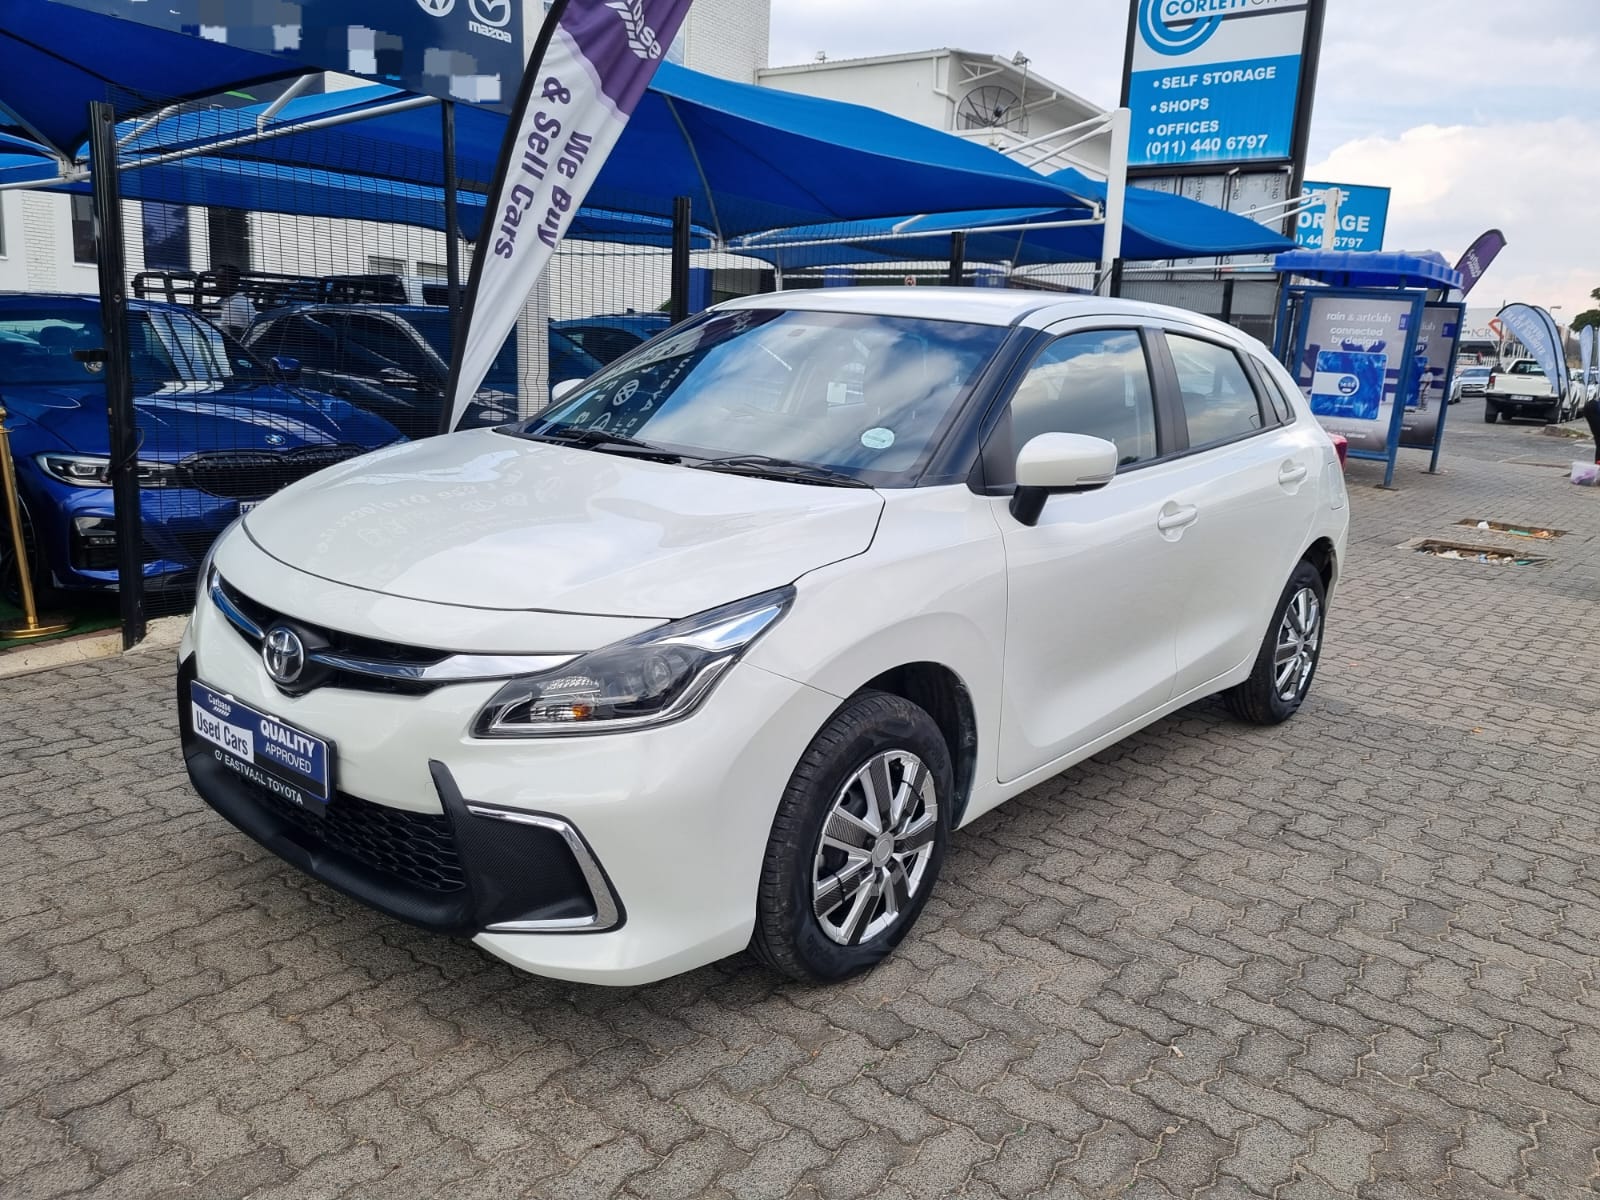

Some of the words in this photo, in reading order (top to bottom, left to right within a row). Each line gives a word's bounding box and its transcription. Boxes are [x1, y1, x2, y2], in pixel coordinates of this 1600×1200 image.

[468, 20, 512, 44] mazda
[541, 76, 571, 105] &
[1161, 74, 1198, 90] SELF
[1202, 66, 1277, 85] STORAGE
[1159, 98, 1210, 114] SHOPS
[1156, 120, 1220, 137] OFFICES
[521, 111, 562, 181] Sell
[556, 130, 592, 180] We
[1146, 141, 1187, 158] (011)
[1190, 137, 1221, 152] 440
[1226, 134, 1268, 151] 6797
[1299, 187, 1351, 208] SEF
[494, 183, 535, 260] Cars
[537, 184, 572, 249] Buy
[1330, 327, 1384, 337] connected
[1330, 335, 1345, 346] by
[1344, 336, 1379, 347] design
[196, 710, 221, 742] Used
[223, 725, 249, 755] Cars
[259, 719, 315, 758] QUALITY
[264, 741, 312, 774] APPROVED
[224, 755, 266, 786] EASTVAAL
[267, 776, 304, 806] TOYOTA
